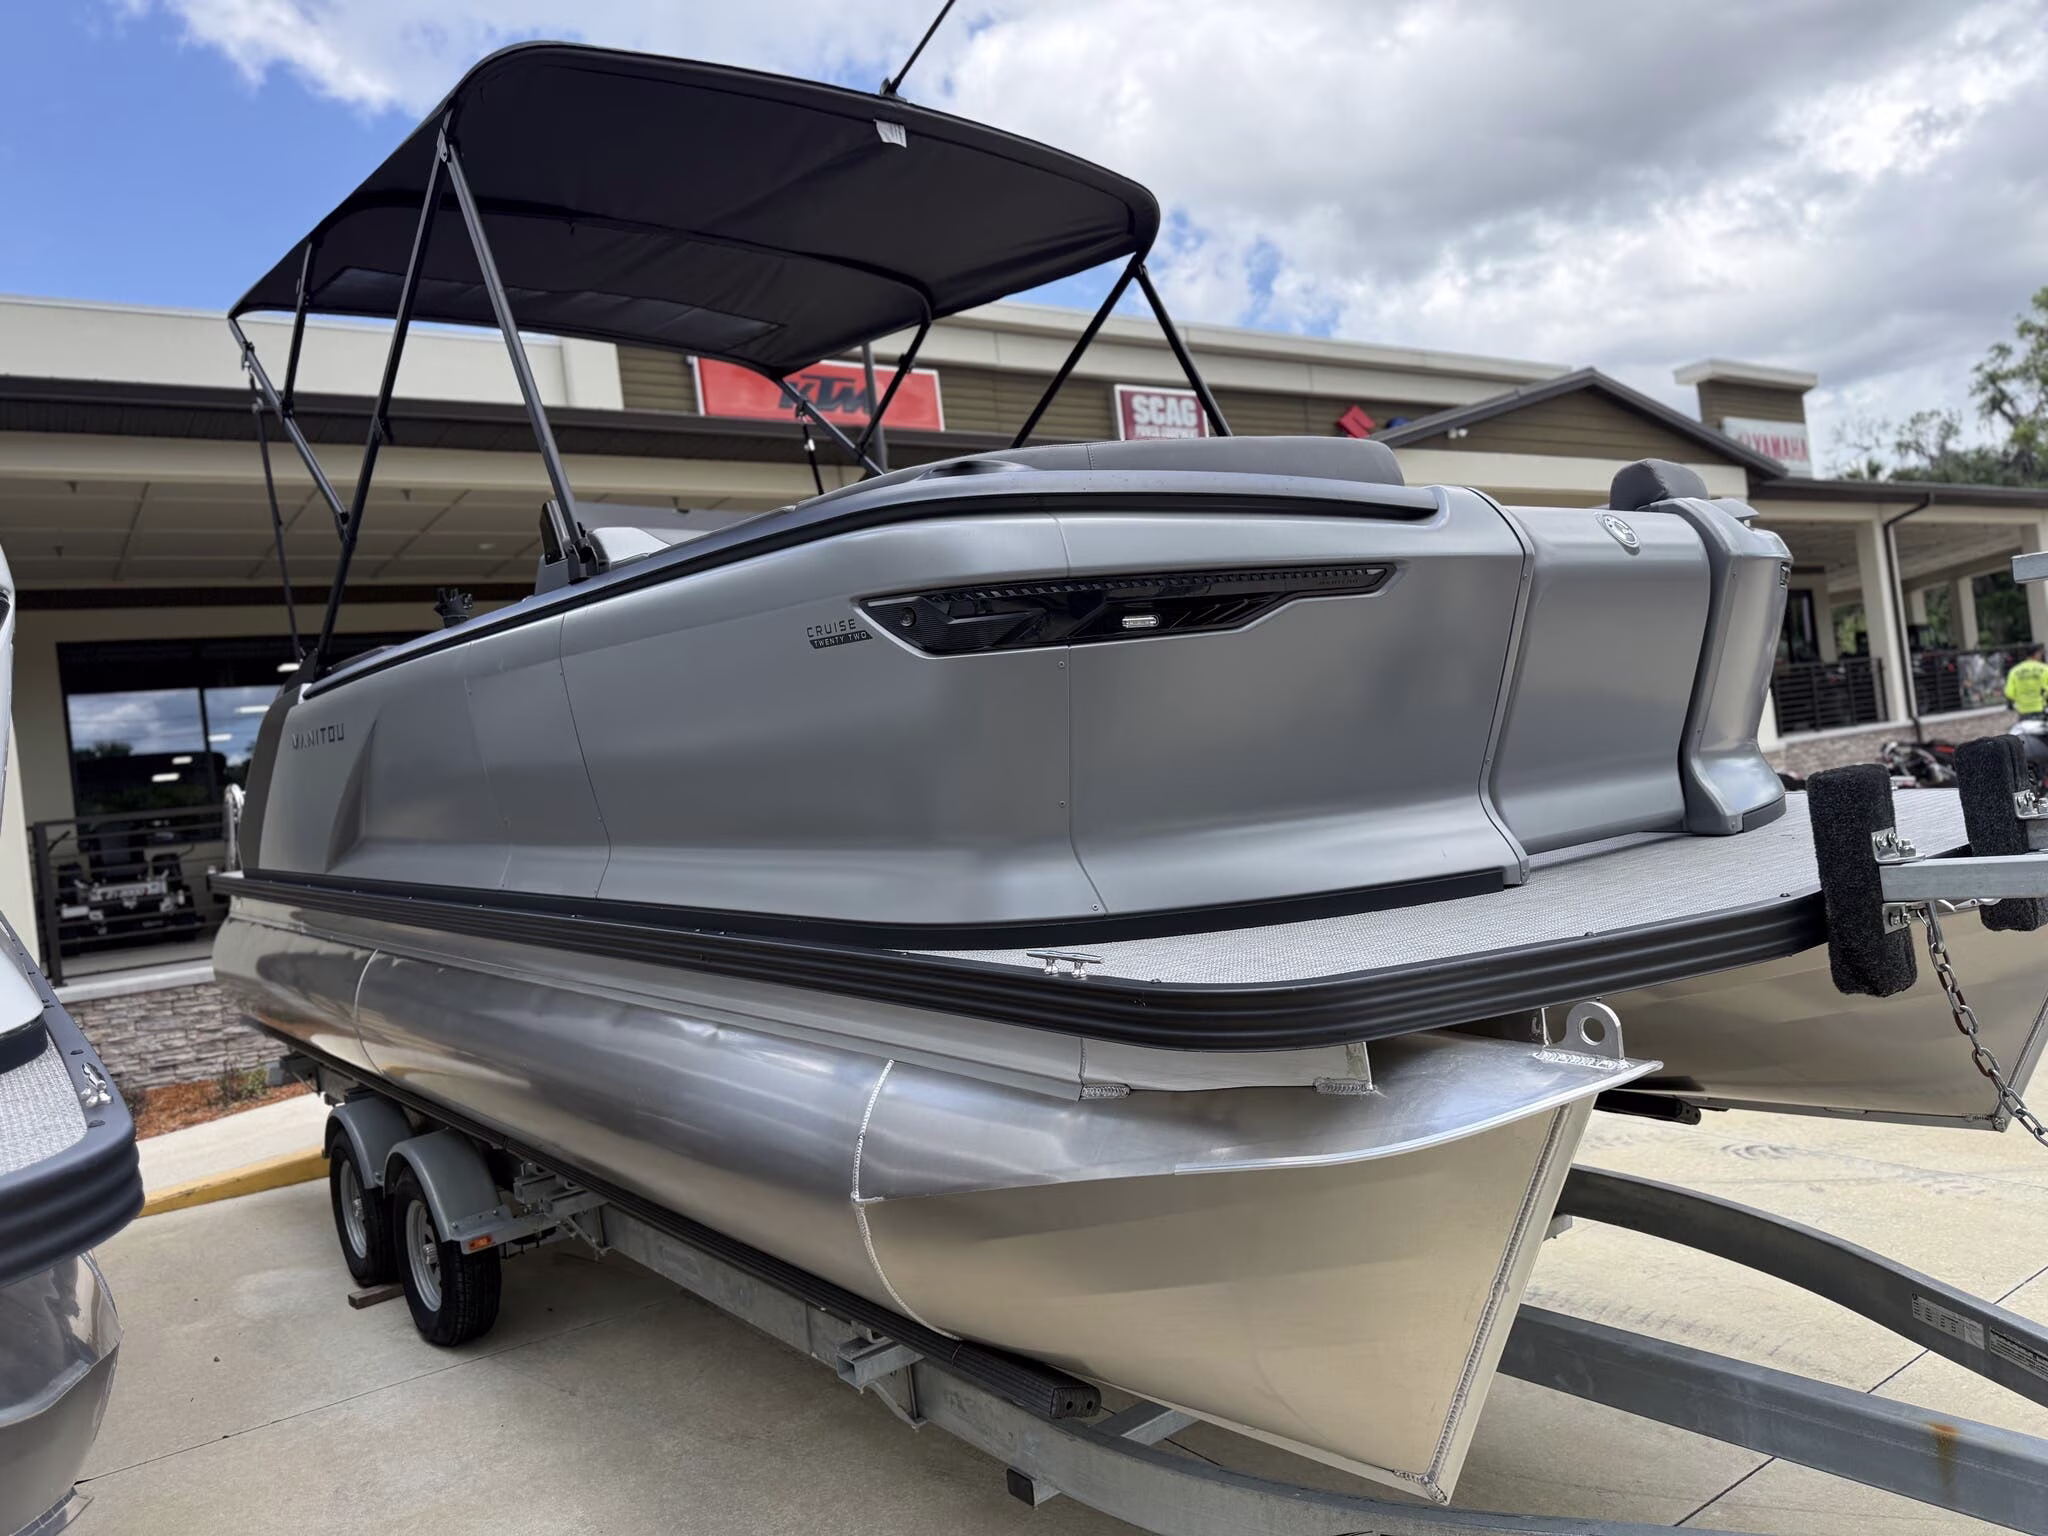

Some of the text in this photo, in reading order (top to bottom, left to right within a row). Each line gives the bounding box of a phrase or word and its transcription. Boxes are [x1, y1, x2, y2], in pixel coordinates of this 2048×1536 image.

[779, 374, 873, 415] KTM
[1131, 394, 1197, 427] SCAG
[806, 618, 857, 638] CRUISE
[814, 631, 868, 648] TWENTY TWO
